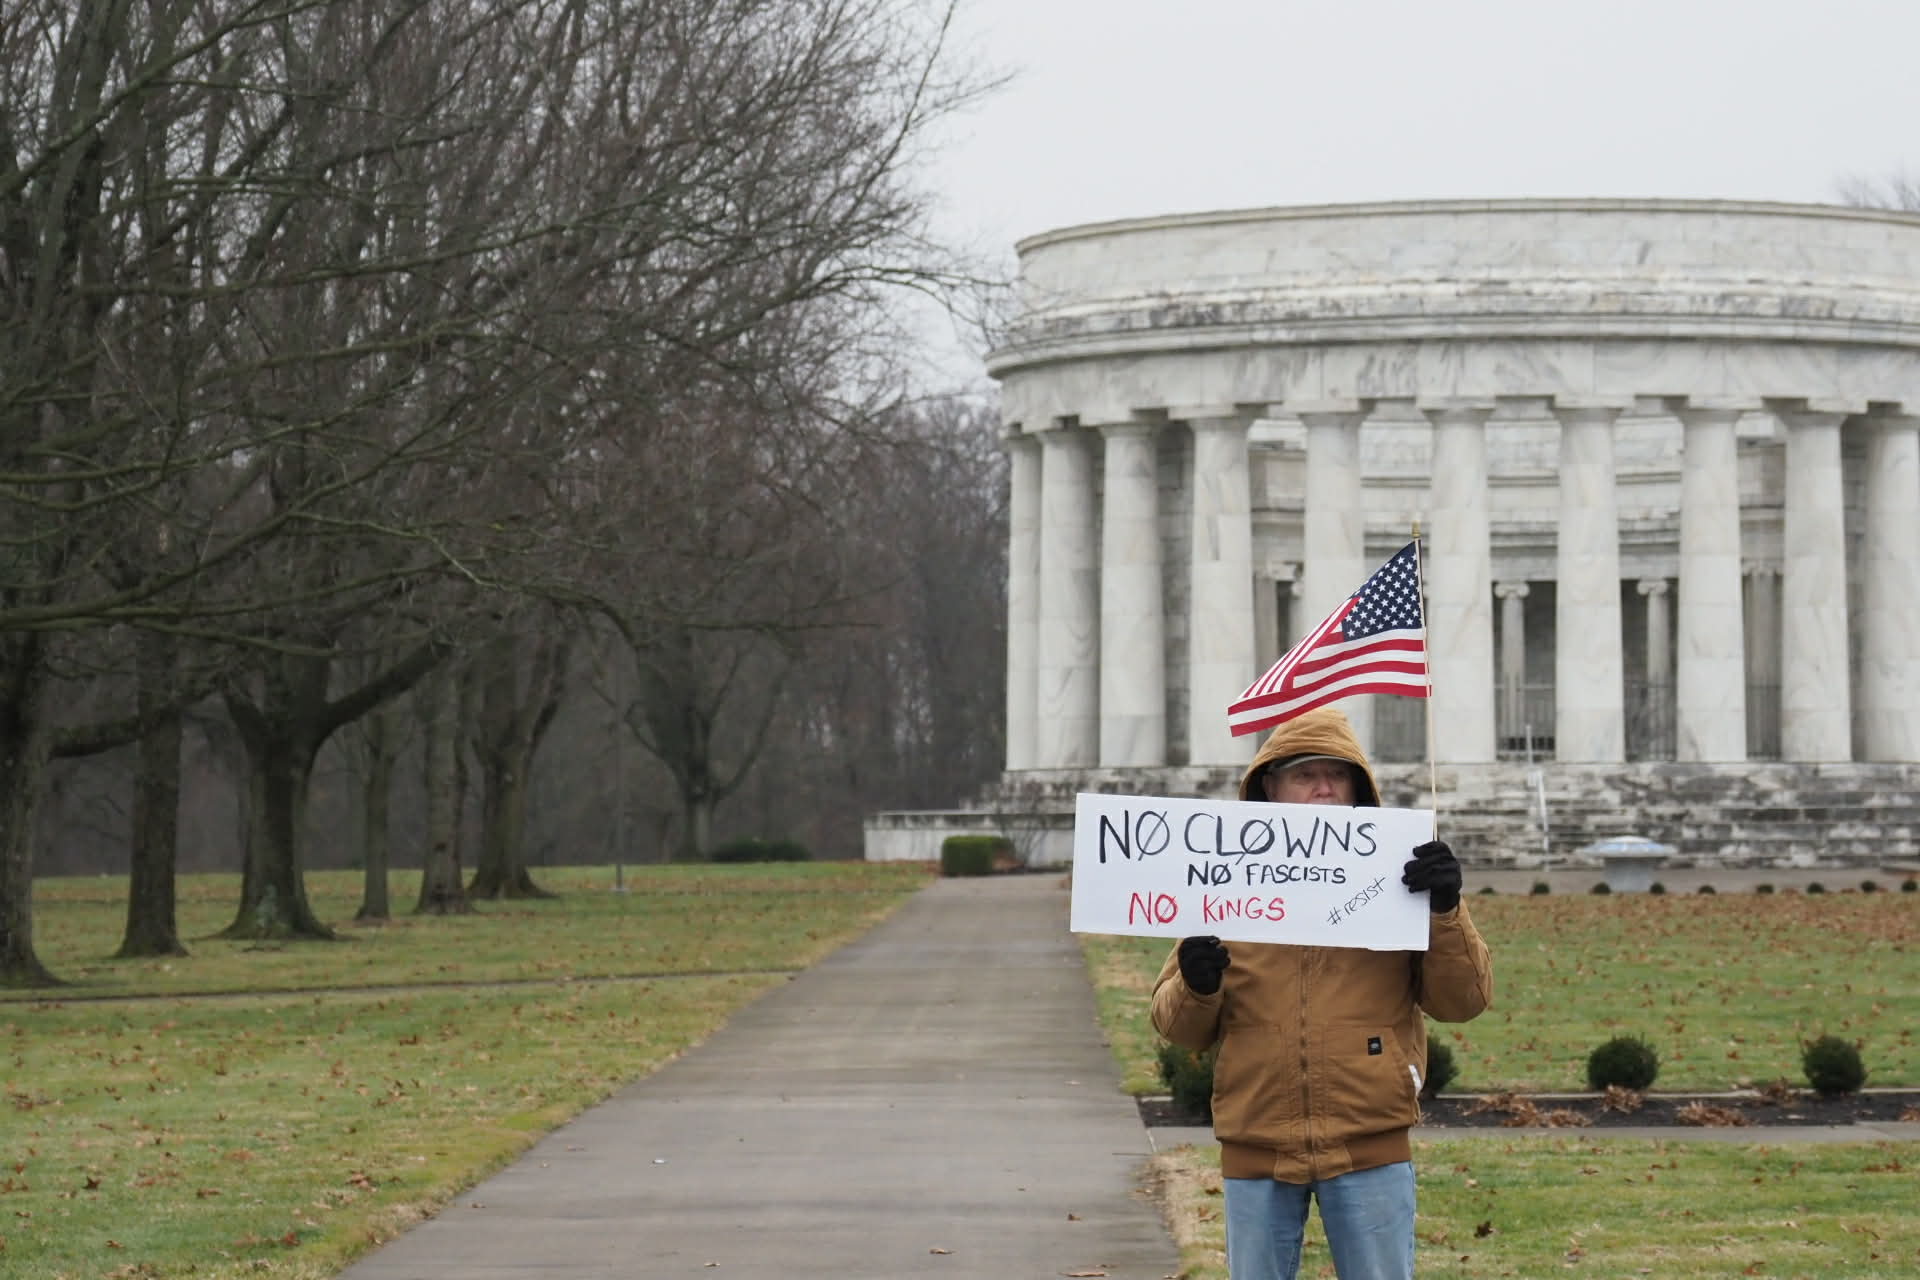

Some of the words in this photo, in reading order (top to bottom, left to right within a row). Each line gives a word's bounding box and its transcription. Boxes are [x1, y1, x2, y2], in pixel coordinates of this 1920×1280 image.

[1245, 862, 1346, 886] FASCISTS
[1203, 894, 1285, 924] KINGS
[1327, 877, 1386, 925] #resist
